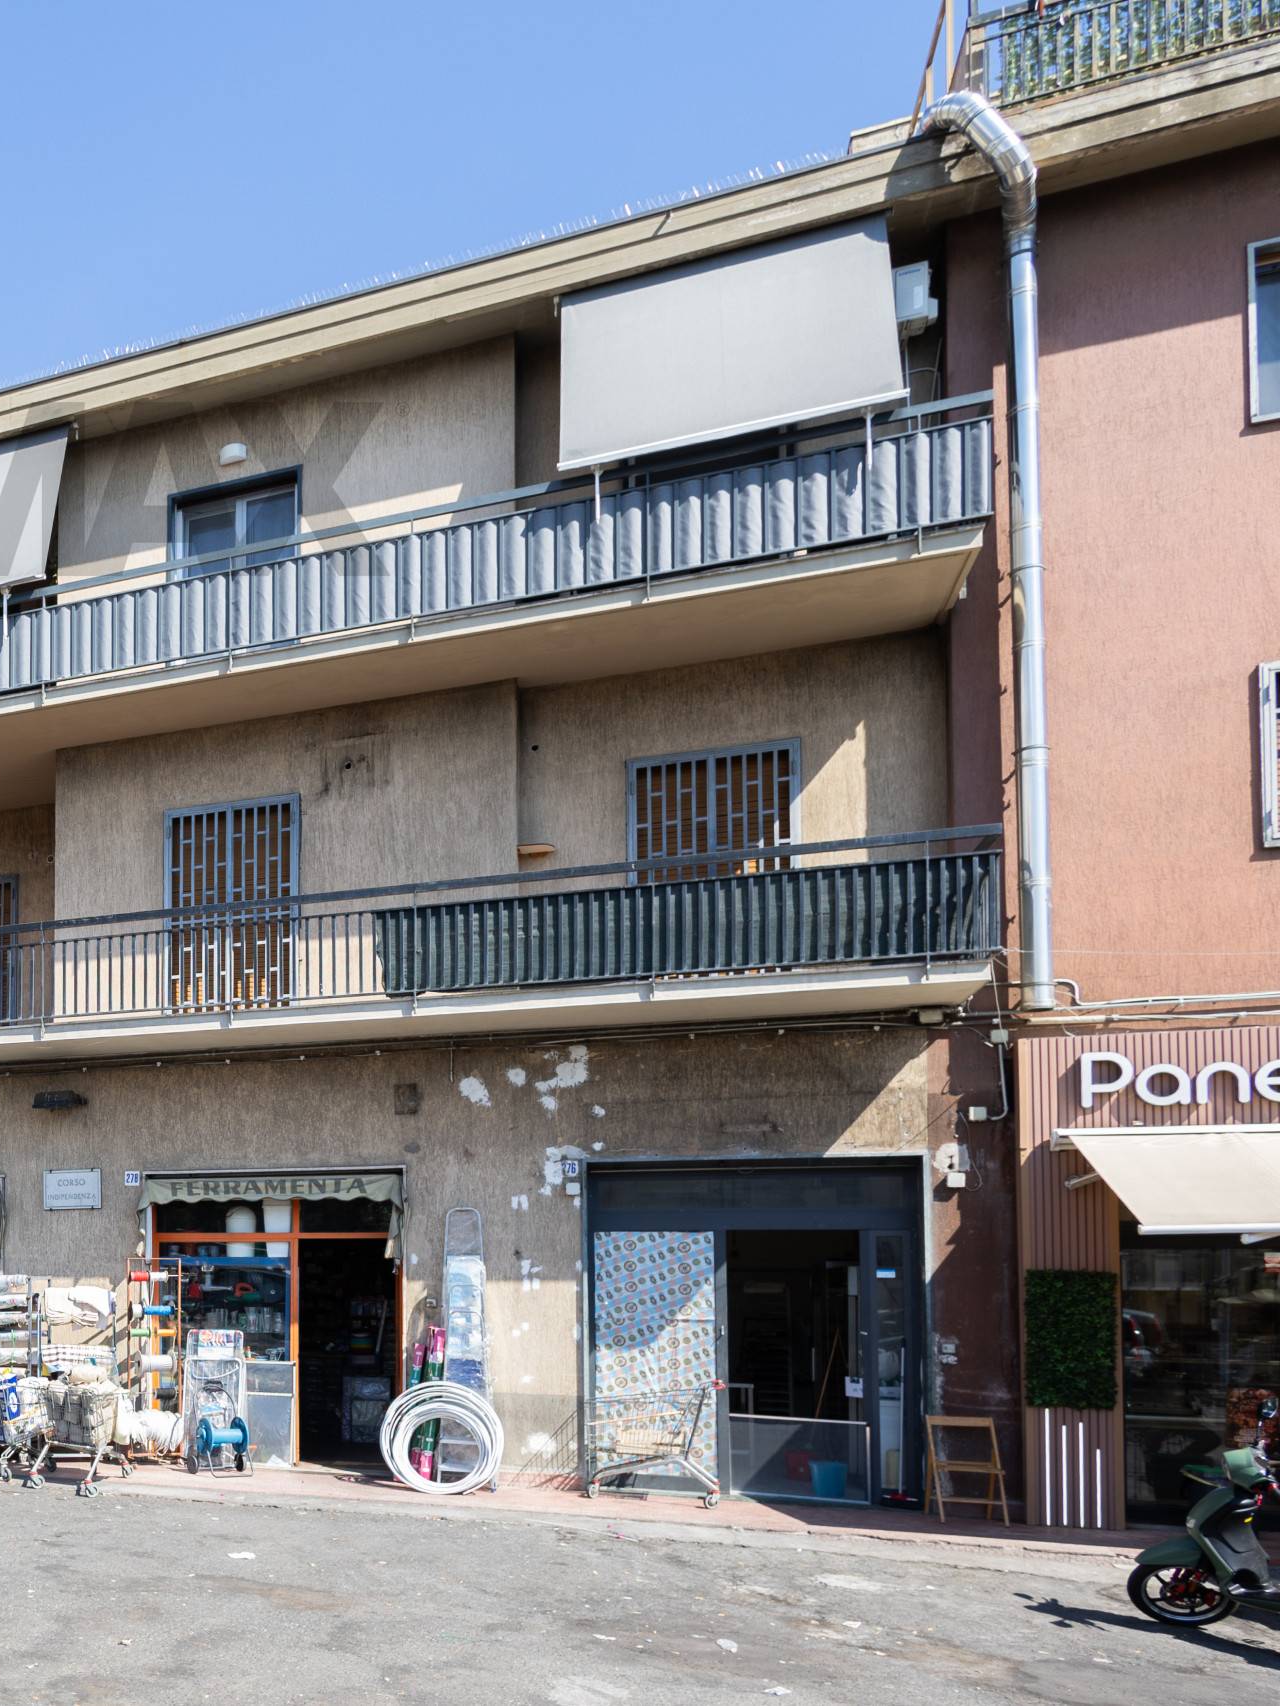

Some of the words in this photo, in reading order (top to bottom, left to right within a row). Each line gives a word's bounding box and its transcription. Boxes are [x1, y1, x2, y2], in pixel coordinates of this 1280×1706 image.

[57, 1178, 86, 1187] CORSO
[126, 1173, 139, 1184] 278
[170, 1177, 367, 1197] FERRAMENTA
[47, 1192, 97, 1201] INDIPENDENZA
